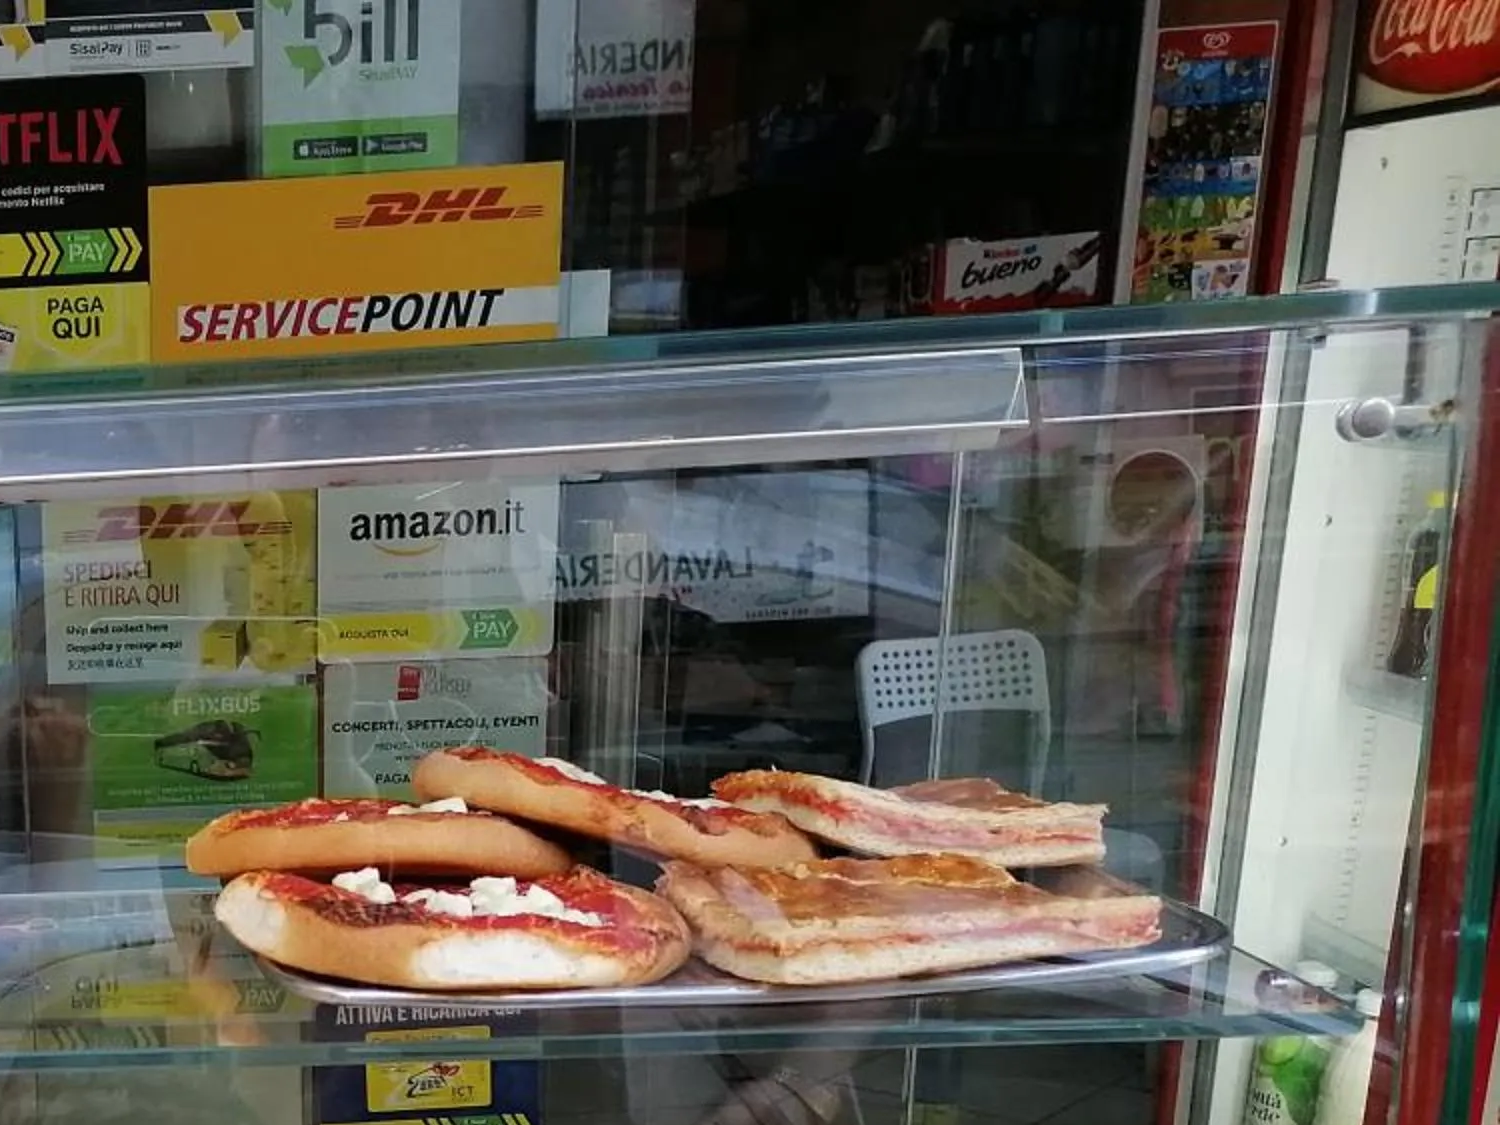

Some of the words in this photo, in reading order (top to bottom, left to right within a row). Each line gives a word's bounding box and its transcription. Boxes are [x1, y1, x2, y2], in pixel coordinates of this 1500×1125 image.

[1, 184, 32, 196] codici
[33, 185, 51, 197] per
[53, 182, 105, 195] acquistare
[32, 196, 64, 208] Netflix
[363, 187, 515, 227] DHL
[69, 242, 107, 263] PAY
[962, 255, 1042, 289] bueno
[48, 297, 104, 314] PAGA
[179, 288, 504, 343] SERVICEPOINT
[53, 317, 101, 339] QUI
[97, 502, 260, 541] DHL
[351, 499, 525, 541] amazon.it
[64, 560, 152, 583] SPEDISCI
[65, 589, 75, 608] E
[81, 586, 140, 607] RITIRA
[146, 584, 179, 604] QUI
[339, 630, 387, 640] ACQUISTA
[391, 628, 409, 638] QUI
[473, 621, 512, 639] PAY
[173, 694, 261, 716] FLIXBUS
[332, 720, 402, 734] CONCERTI,
[406, 717, 489, 732] SPETTACOLI,
[493, 715, 539, 728] EVENTI
[375, 773, 409, 784] PAGA
[336, 1004, 393, 1025] ATTIVA
[398, 1007, 407, 1021] E
